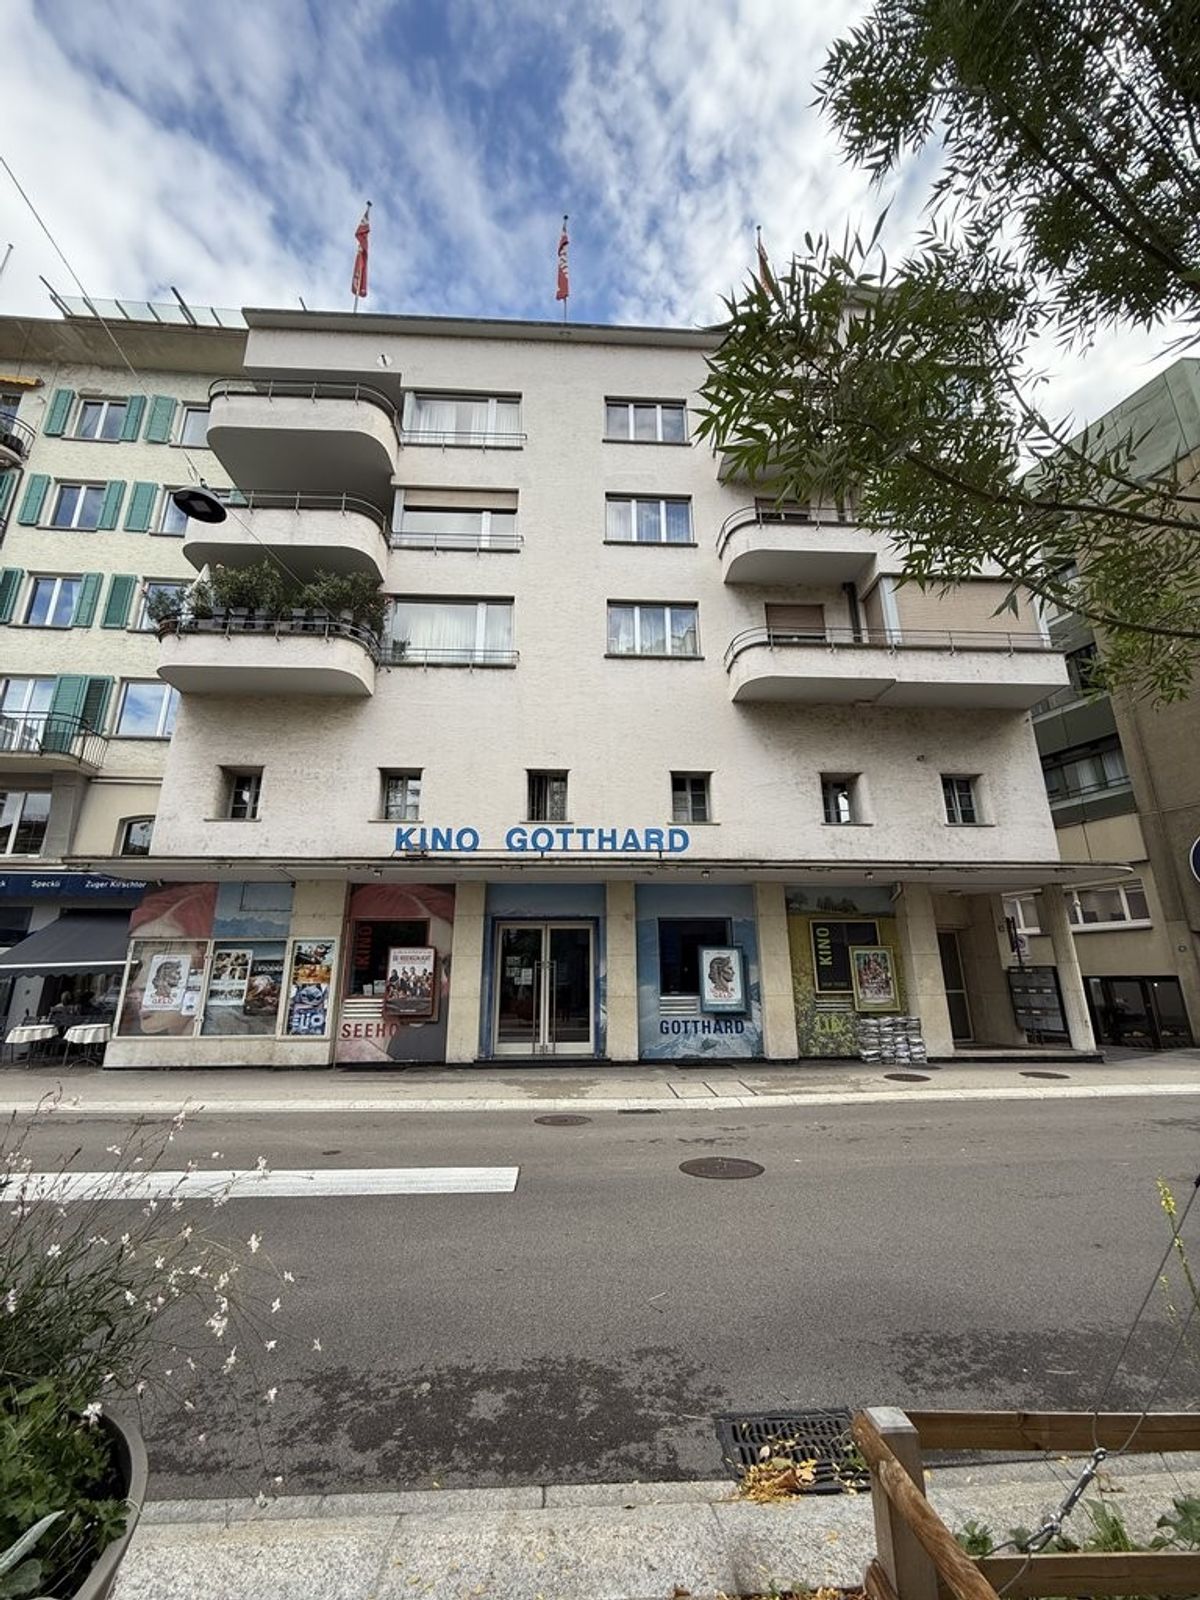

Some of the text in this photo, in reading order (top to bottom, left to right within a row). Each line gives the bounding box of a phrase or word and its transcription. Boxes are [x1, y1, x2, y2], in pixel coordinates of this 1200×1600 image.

[395, 827, 690, 853] KINO GOTTHARD
[355, 926, 373, 966] KINO
[815, 927, 833, 966] KINO
[660, 1020, 745, 1035] GOTTHARD
